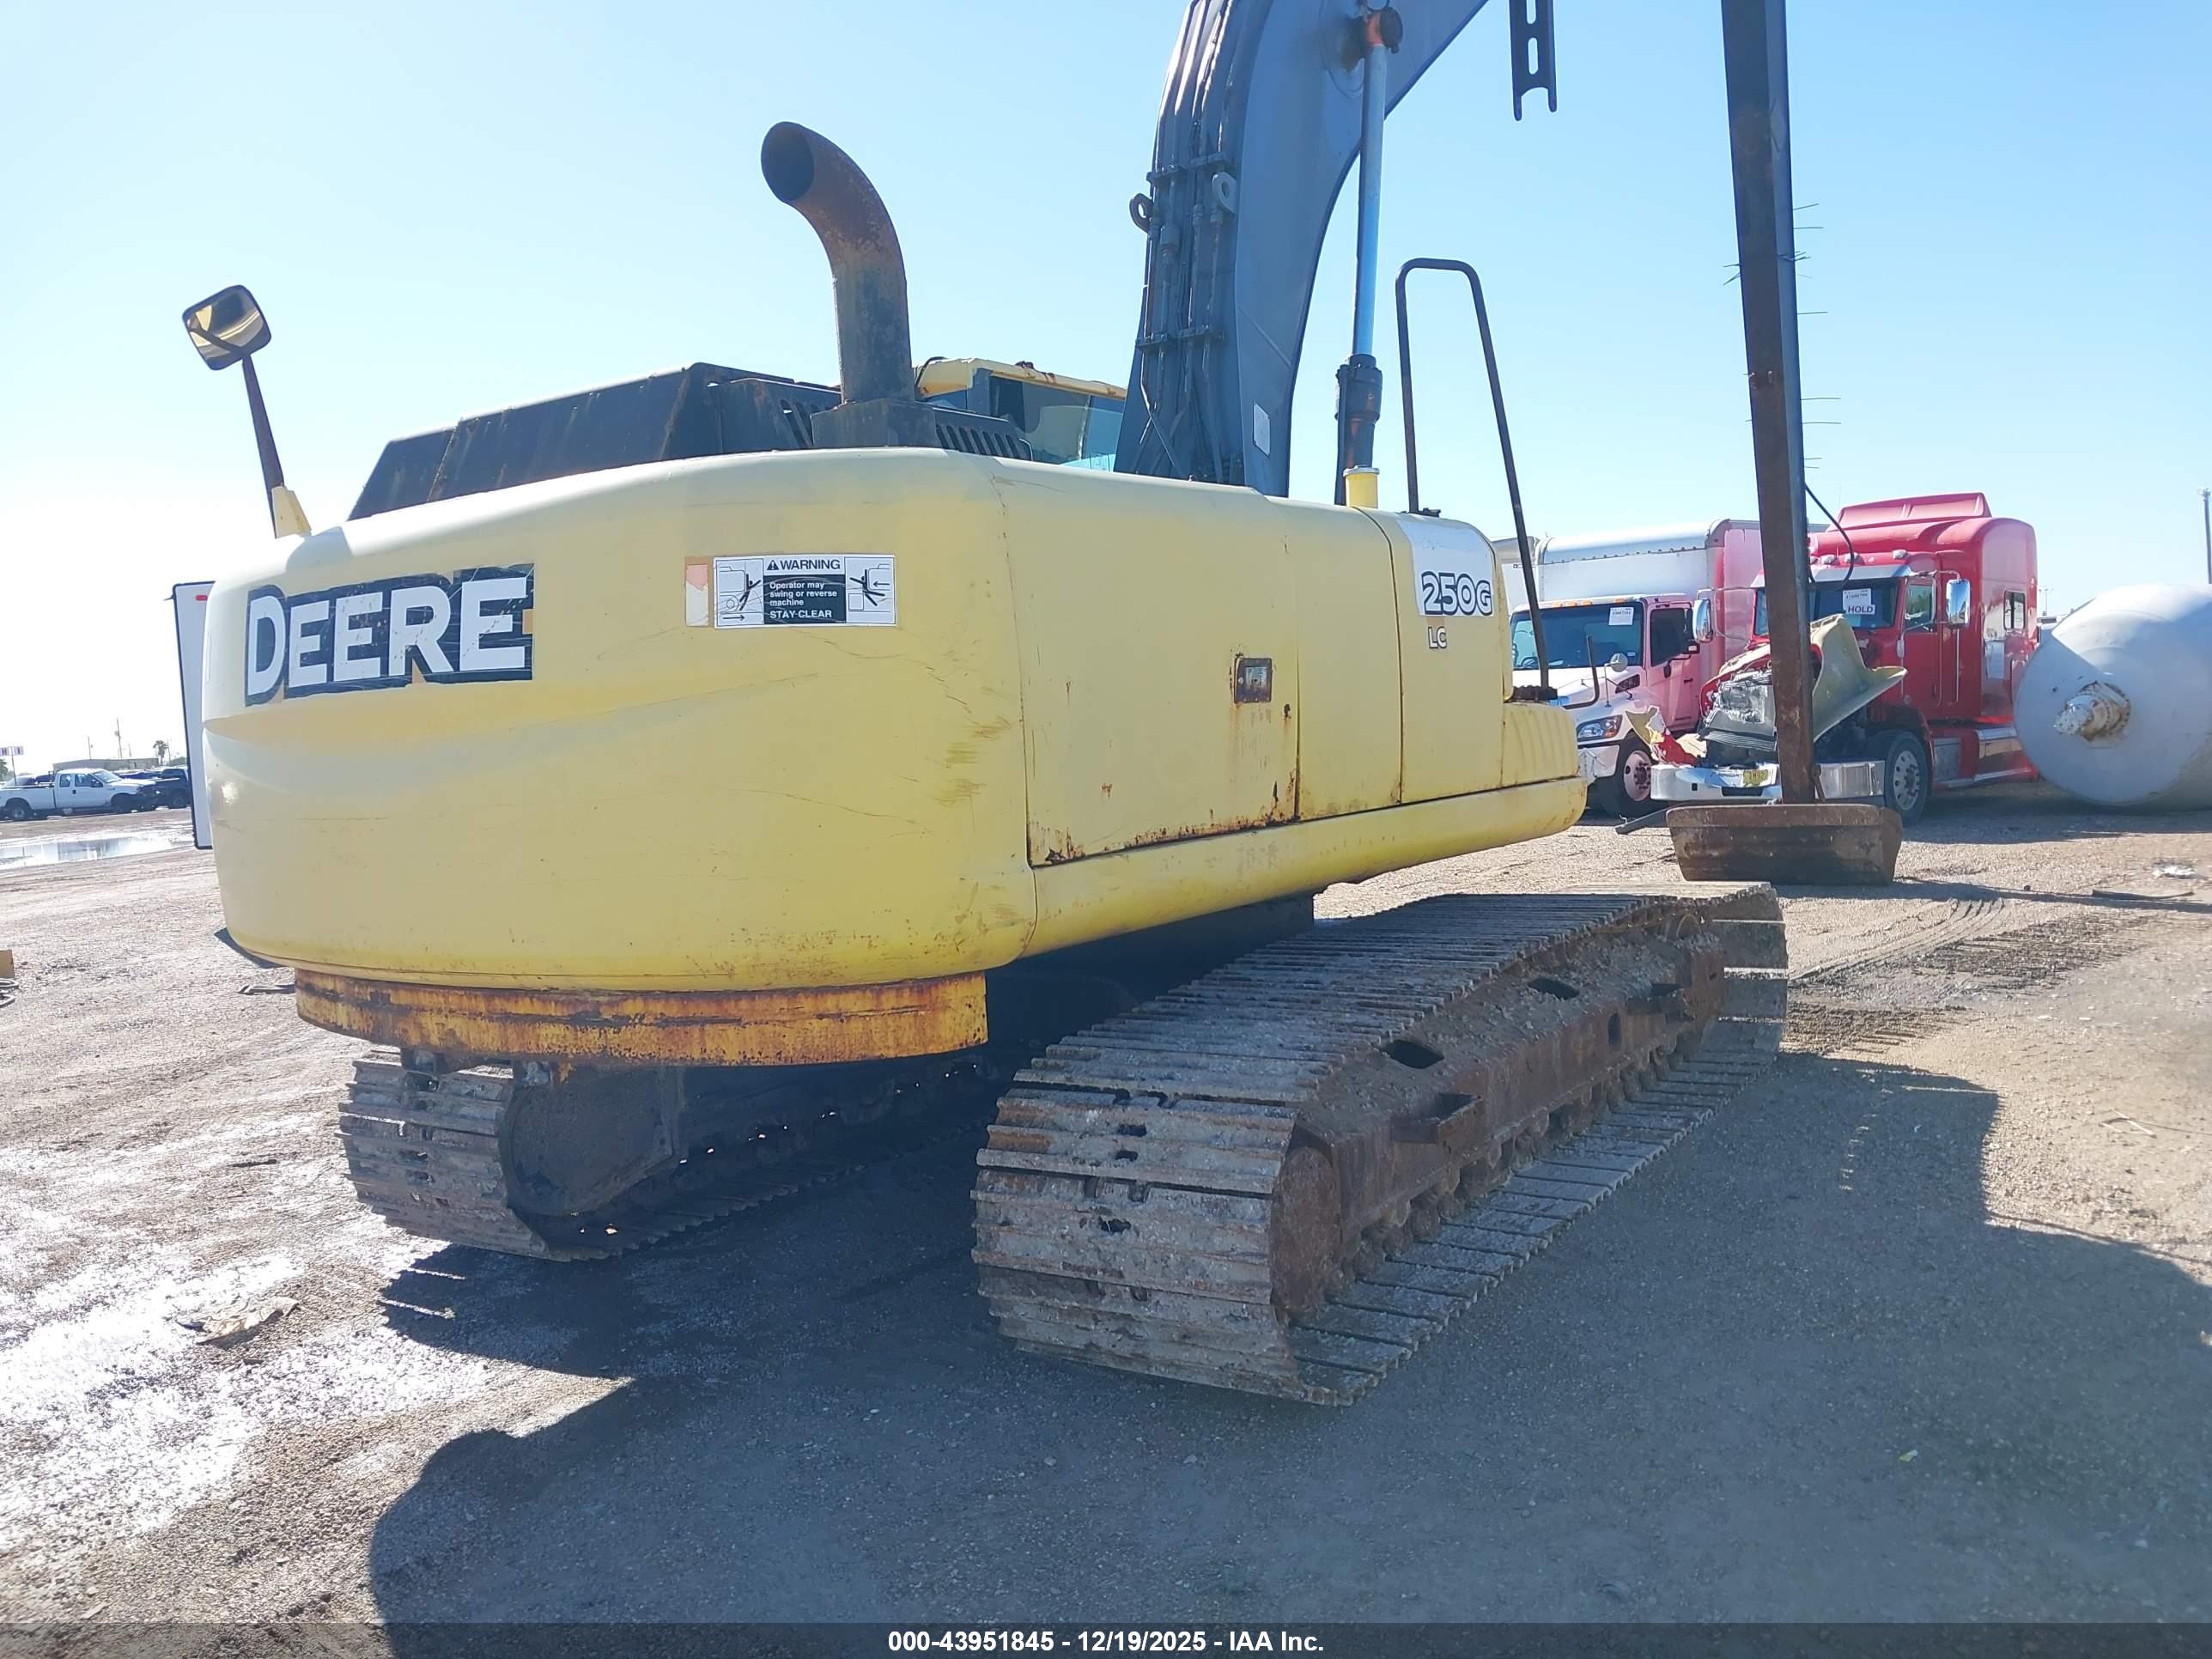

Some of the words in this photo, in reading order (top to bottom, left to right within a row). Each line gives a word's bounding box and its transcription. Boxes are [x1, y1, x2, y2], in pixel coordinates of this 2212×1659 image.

[780, 559, 841, 570] WARNING
[769, 581, 805, 590] Operator
[807, 581, 825, 590] may
[769, 589, 794, 599] swing
[1421, 571, 1493, 616] 250G
[246, 567, 533, 704] DEERE
[1428, 626, 1448, 649] LC
